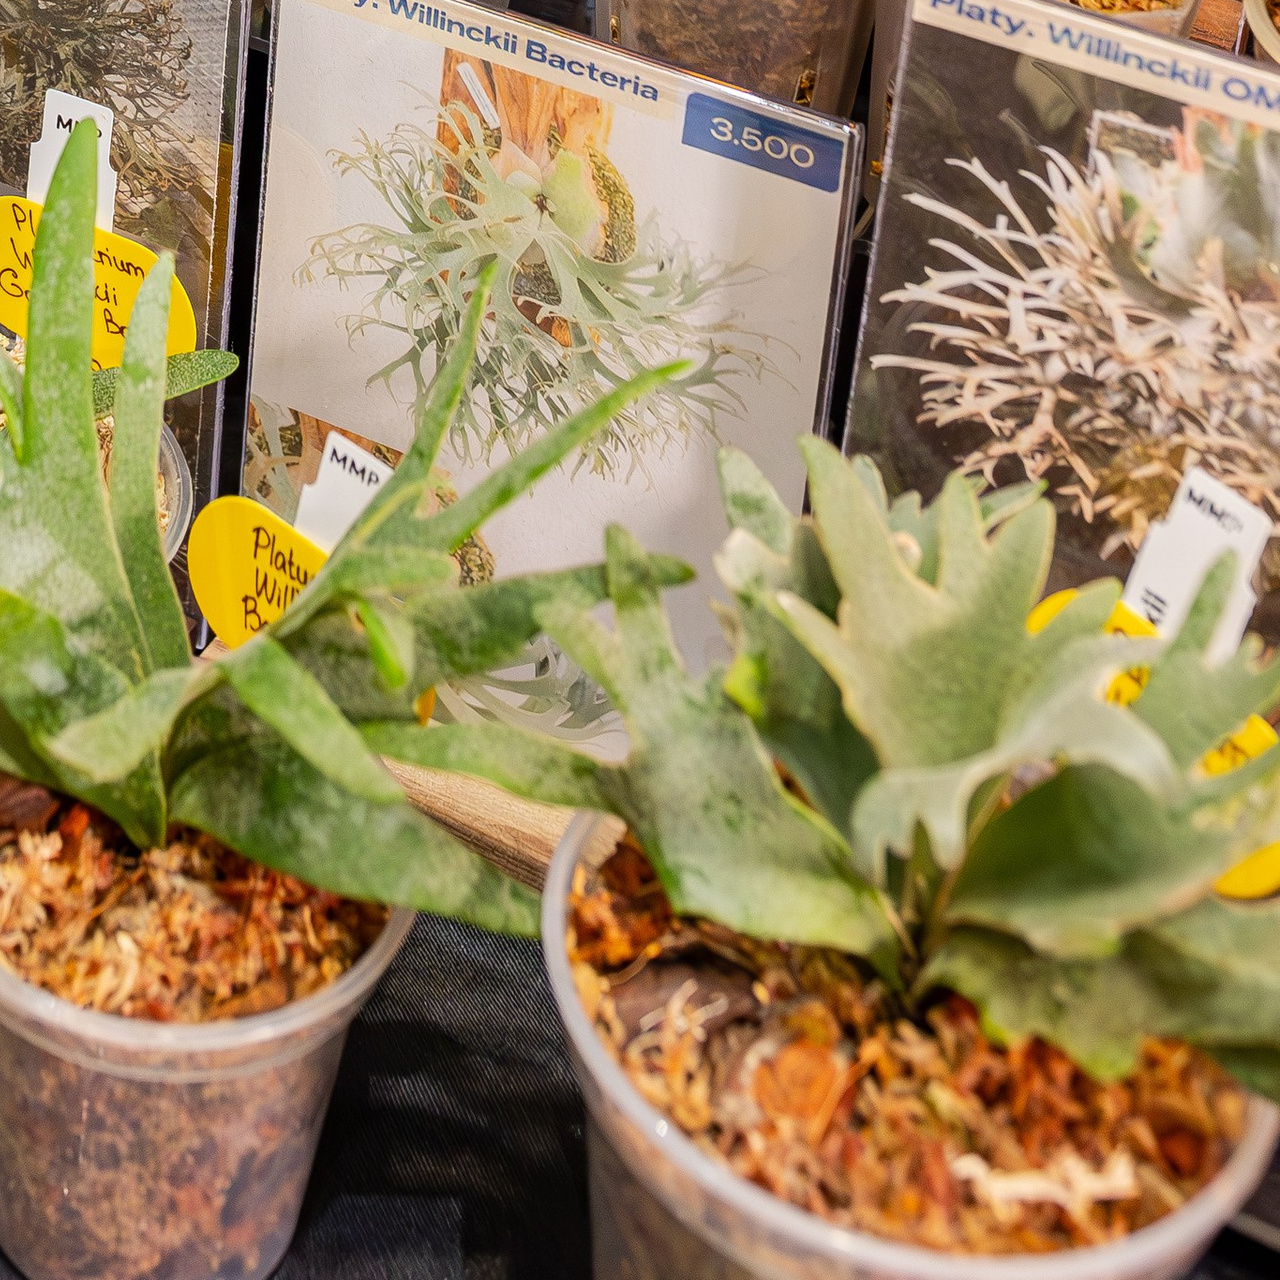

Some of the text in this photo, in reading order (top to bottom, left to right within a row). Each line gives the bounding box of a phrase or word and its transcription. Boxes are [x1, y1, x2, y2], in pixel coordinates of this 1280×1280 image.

[525, 39, 660, 103] Bacteria
[1047, 21, 1214, 92] Willinckii
[709, 116, 816, 170] 3.500
[330, 447, 380, 488] MMP
